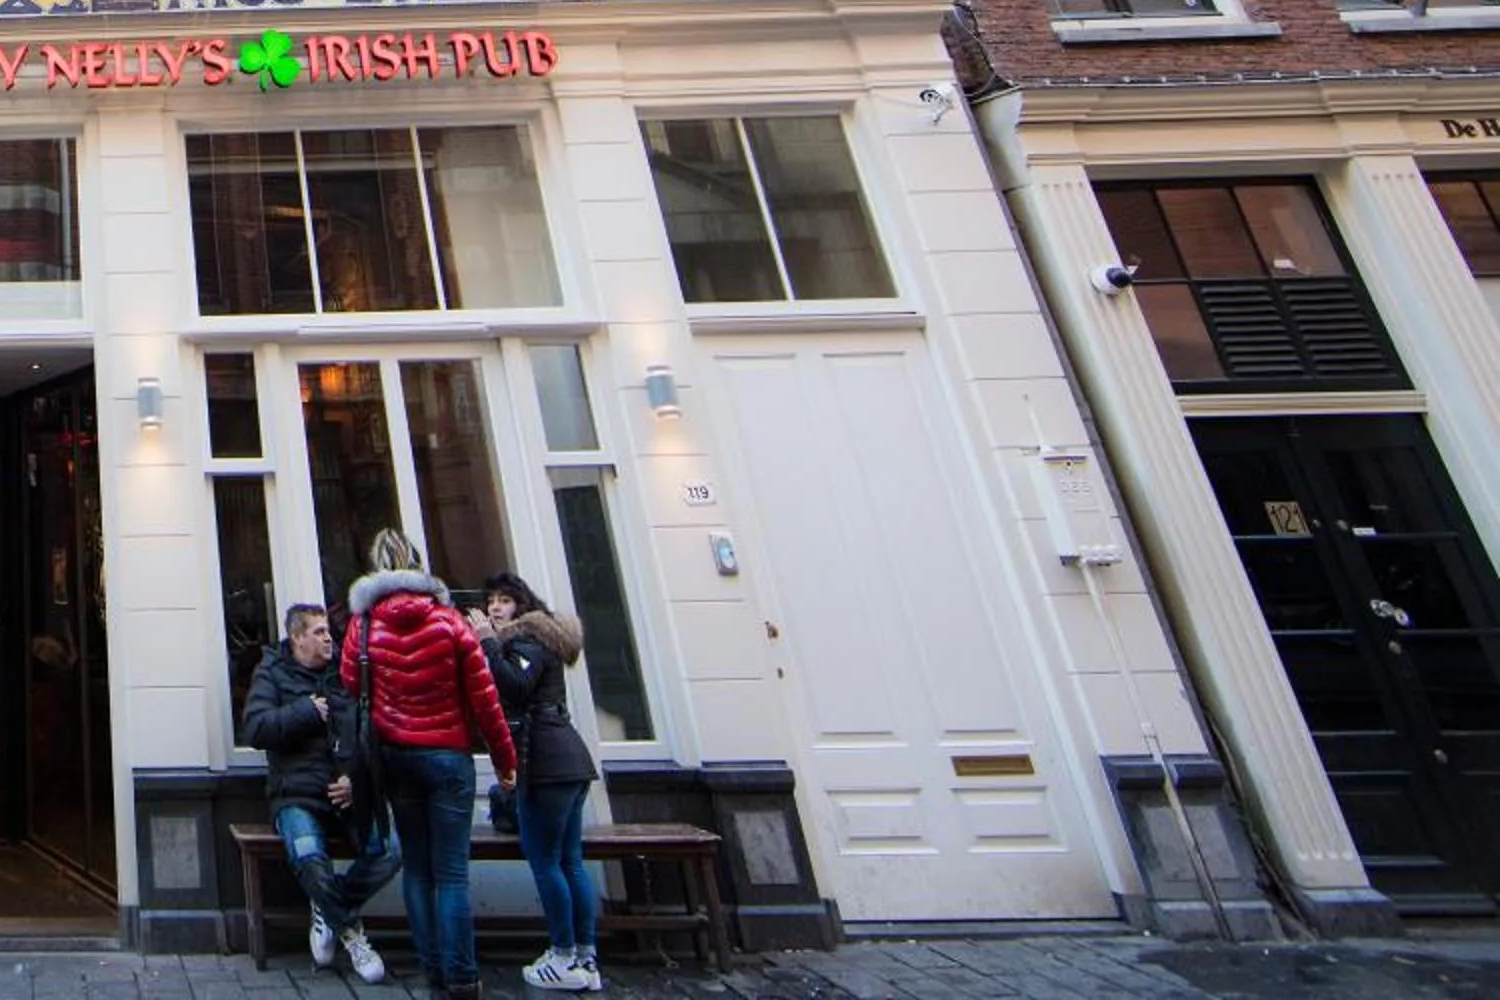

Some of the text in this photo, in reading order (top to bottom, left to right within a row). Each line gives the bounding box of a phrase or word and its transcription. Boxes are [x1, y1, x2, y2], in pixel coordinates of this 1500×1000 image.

[40, 39, 233, 88] NELLY'S
[304, 30, 442, 84] IRISH
[446, 28, 560, 80] PUB
[1440, 118, 1477, 138] De
[687, 486, 709, 499] 119
[1270, 504, 1307, 533] 121
